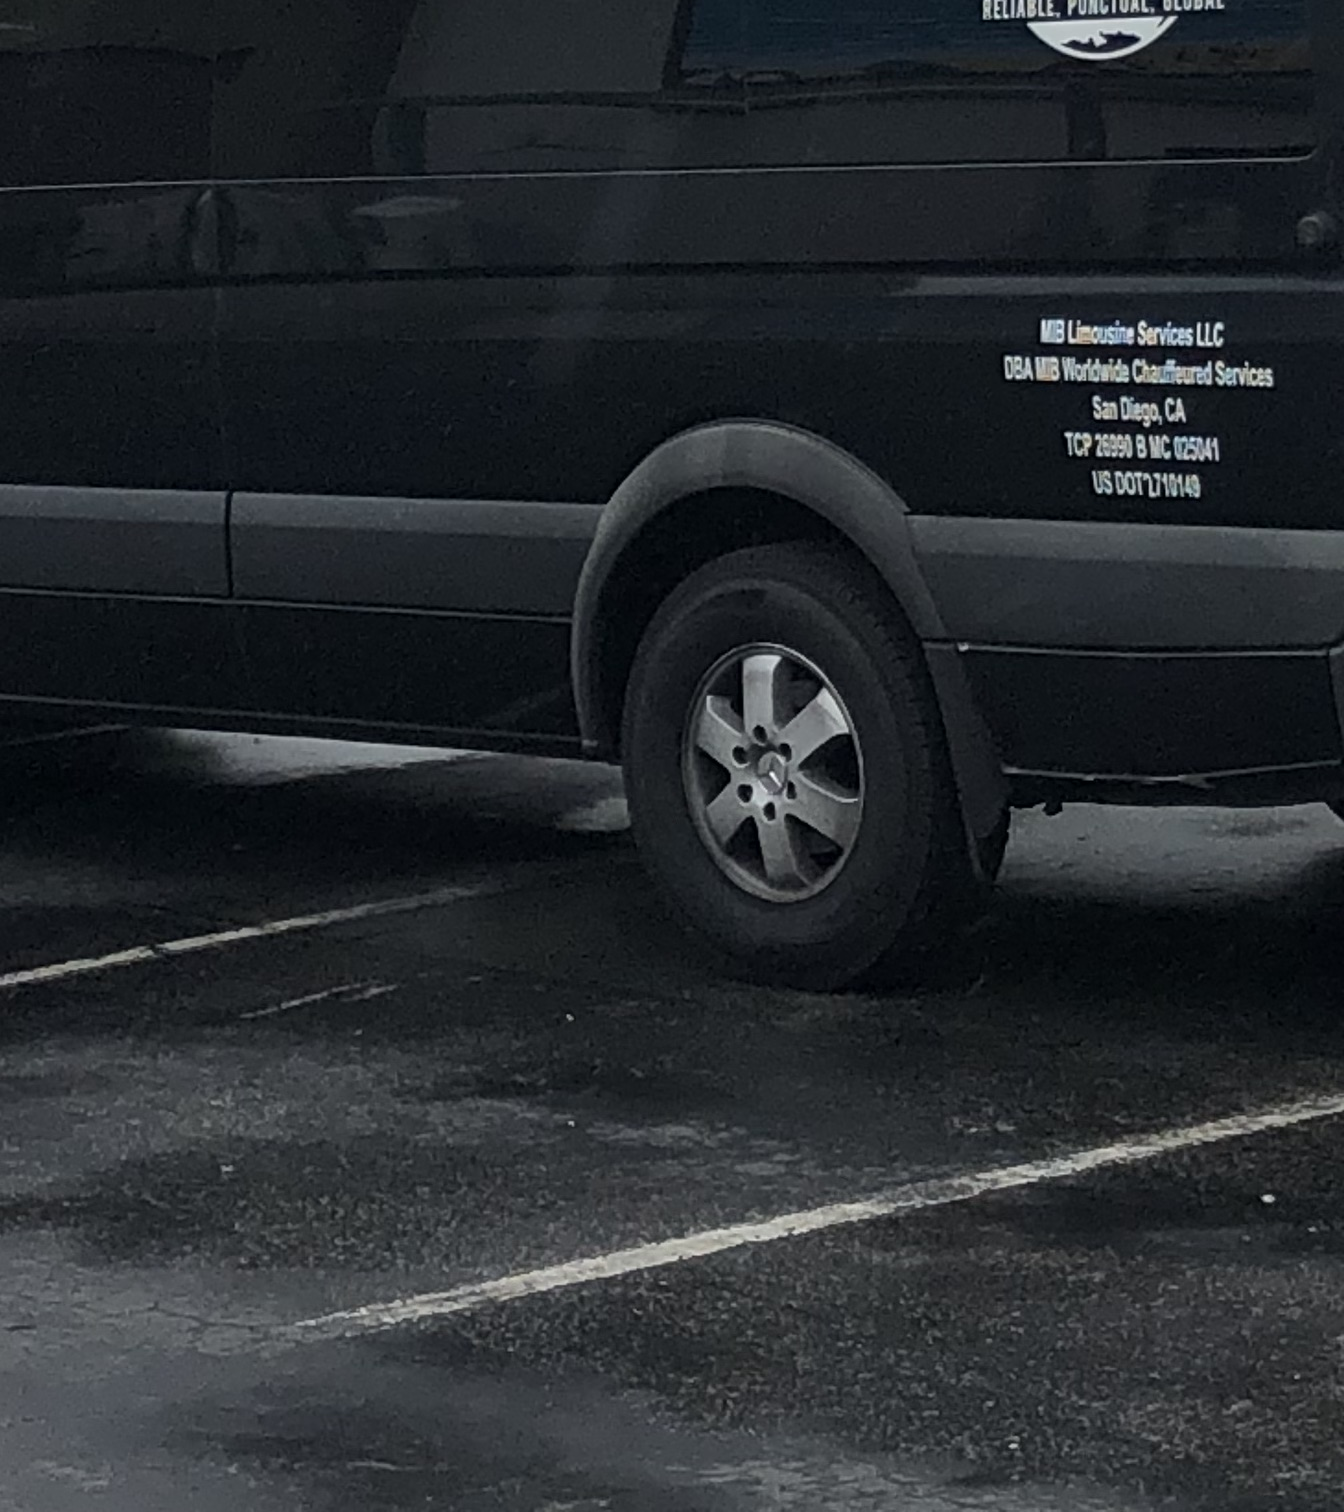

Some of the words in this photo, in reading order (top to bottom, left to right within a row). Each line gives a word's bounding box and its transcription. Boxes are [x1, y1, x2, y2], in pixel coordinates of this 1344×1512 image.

[1040, 319, 1065, 344] MIB
[1067, 319, 1135, 345] Limousine
[1137, 320, 1194, 347] Services
[1196, 322, 1225, 347] LLC
[1004, 355, 1033, 381] DBA
[1034, 356, 1061, 381] MIB
[1062, 356, 1130, 384] Worldwide
[1132, 358, 1212, 385] Chauffeured
[1214, 360, 1275, 388] Services
[1091, 395, 1119, 421] San
[1119, 395, 1163, 428] Diego,
[1164, 397, 1187, 424] CA
[1064, 432, 1093, 457] TCP
[1095, 433, 1133, 459] 26990
[1136, 434, 1147, 459] B
[1148, 434, 1172, 460] MC
[1092, 470, 1114, 495] US
